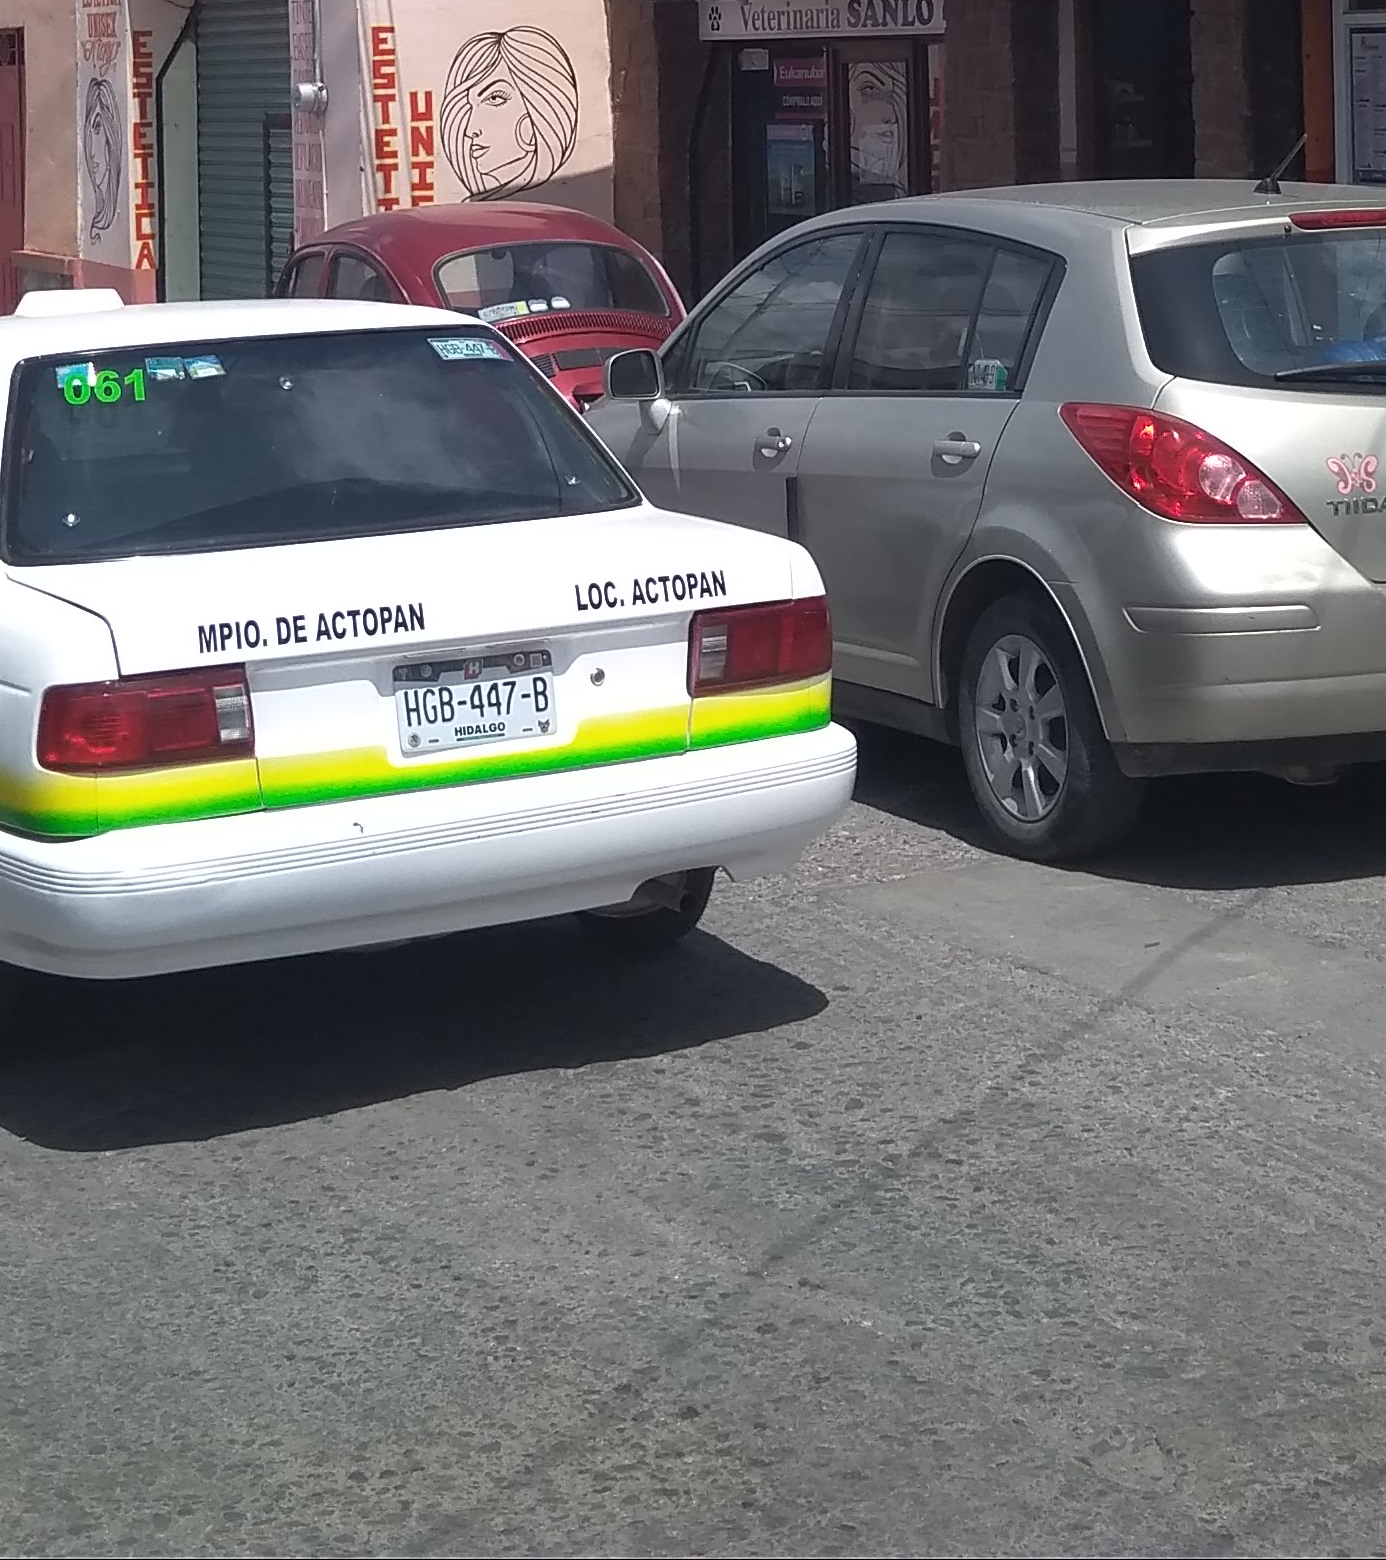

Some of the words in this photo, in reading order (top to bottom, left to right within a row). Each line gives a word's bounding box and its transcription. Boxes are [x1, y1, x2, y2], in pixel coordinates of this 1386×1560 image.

[87, 12, 117, 39] UNISEX
[739, 0, 841, 33] Veterinaria
[779, 64, 824, 80] Eukanuba
[132, 30, 156, 270] ESTETICA
[64, 368, 147, 405] 061
[574, 581, 625, 612] LOC.
[631, 570, 728, 605] ACTOPAN
[197, 618, 268, 654] MPIO.
[275, 613, 308, 644] DE
[316, 602, 426, 640] ACTOPAN
[403, 676, 549, 728] HGB-447-B
[454, 721, 506, 737] HIDALGO
